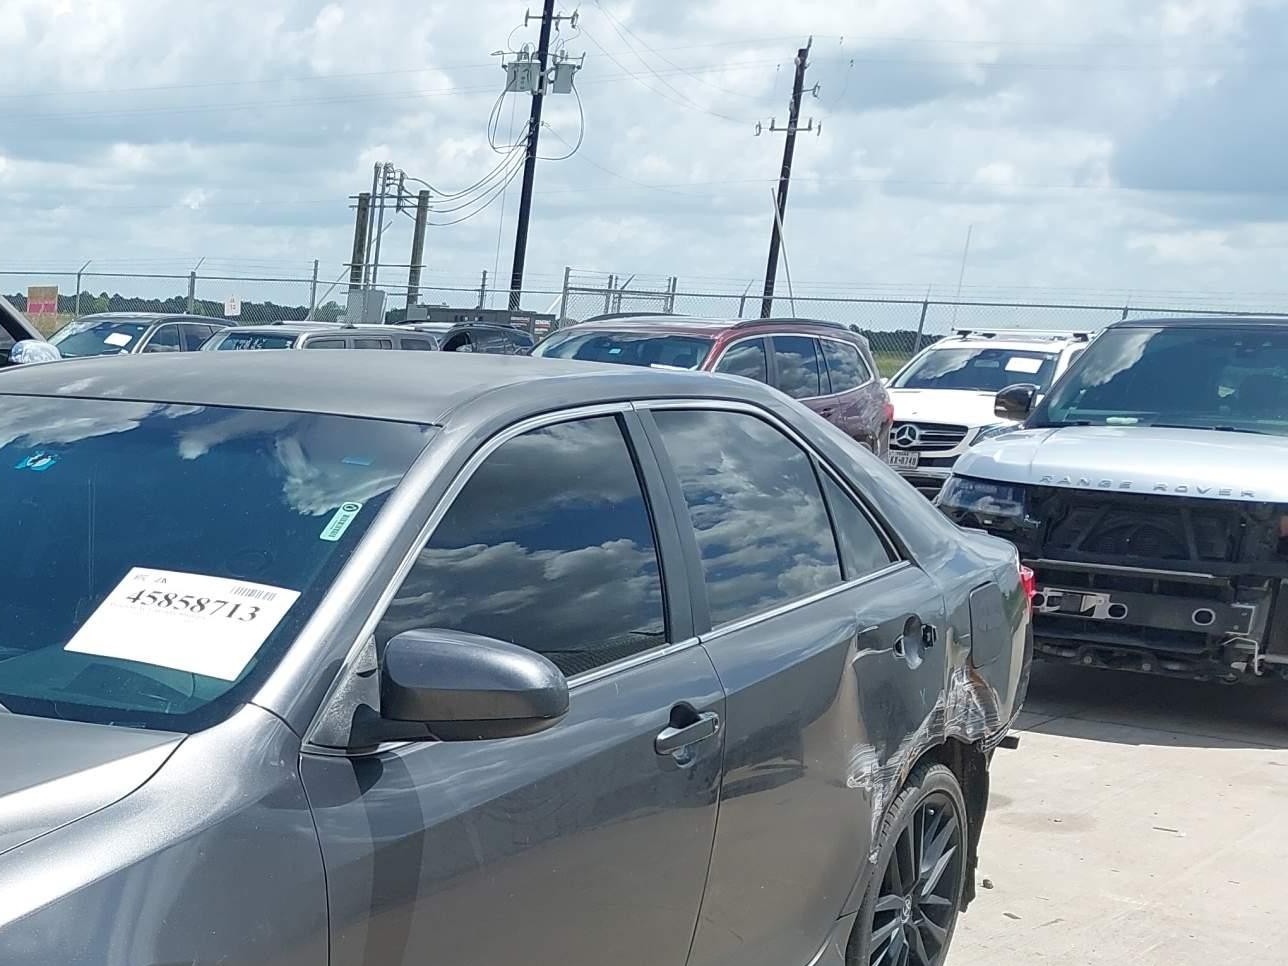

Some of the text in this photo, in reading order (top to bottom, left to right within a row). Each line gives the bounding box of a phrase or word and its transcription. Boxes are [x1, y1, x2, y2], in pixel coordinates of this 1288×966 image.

[1039, 475, 1257, 498] RANGE ROVER
[125, 588, 261, 622] 45858713
